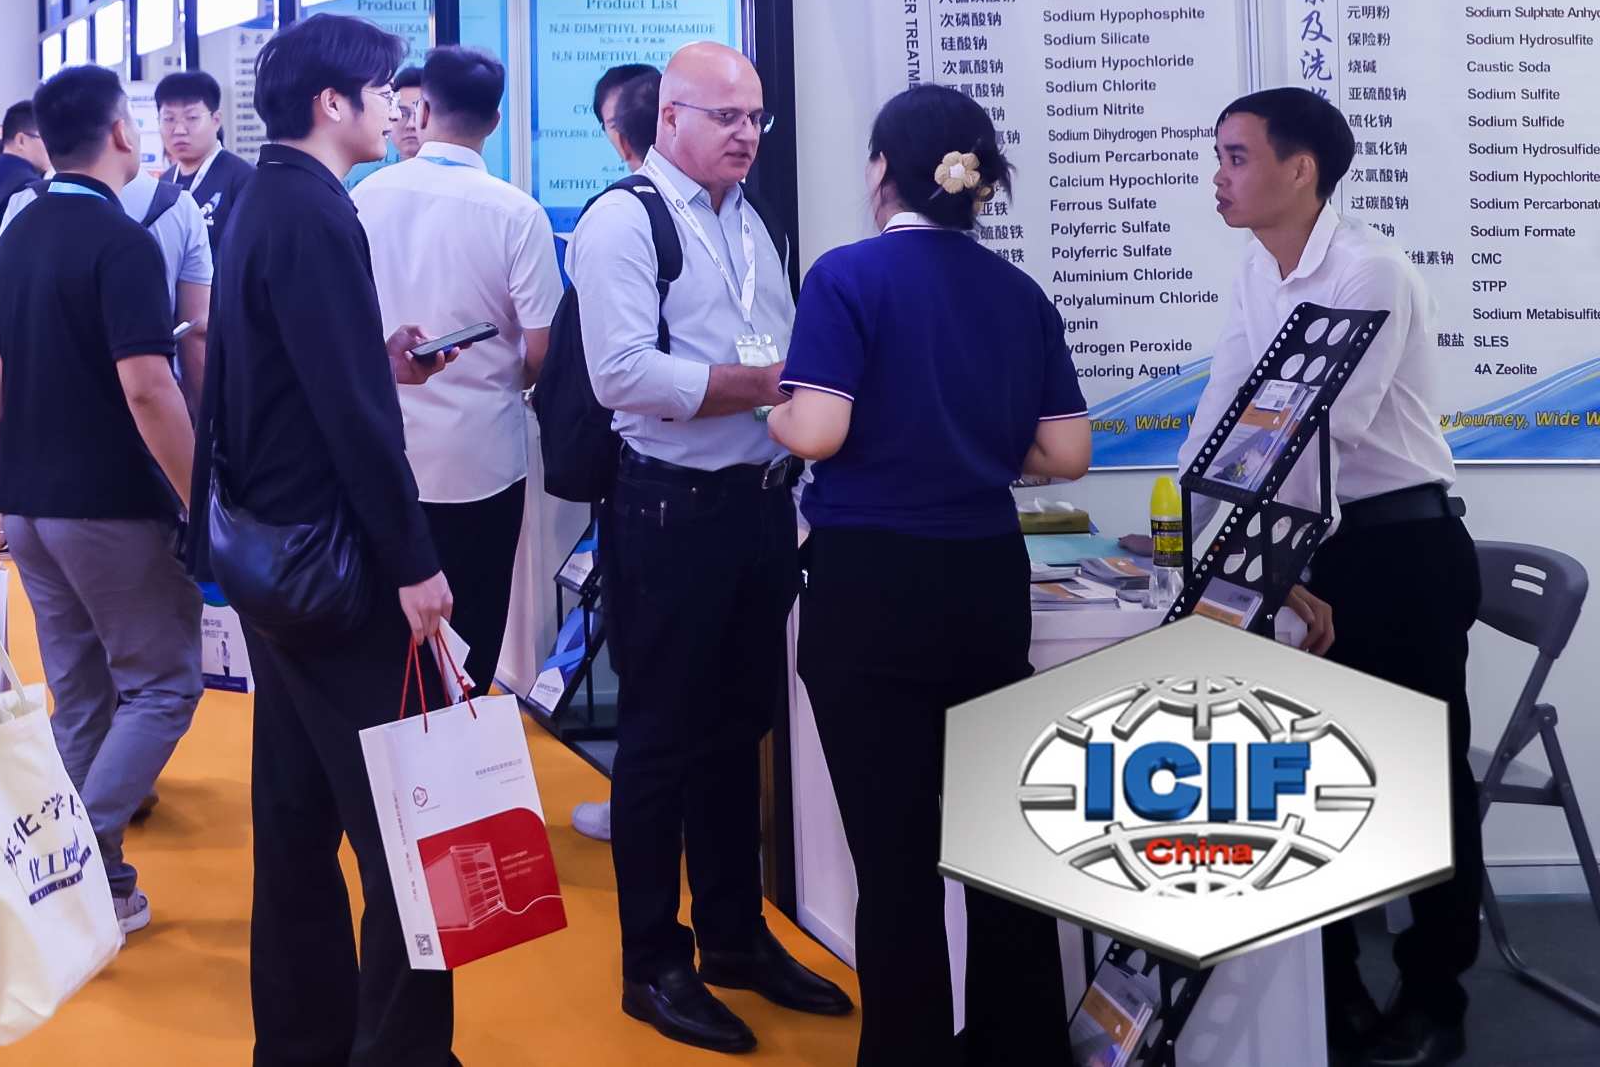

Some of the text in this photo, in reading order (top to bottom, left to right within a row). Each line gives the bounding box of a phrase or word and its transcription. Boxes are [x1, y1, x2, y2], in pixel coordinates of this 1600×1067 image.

[940, 11, 1002, 28] 次磷酸钠
[1043, 6, 1205, 24] Sodium Hypophosphite
[1347, 5, 1390, 20] 元明粉
[1465, 6, 1512, 18] Sodium
[1514, 6, 1565, 21] Sulphate
[940, 35, 988, 52] 硅酸钠
[1043, 32, 1150, 46] Sodium Silicate
[1347, 32, 1391, 47] 保险粉
[1466, 33, 1594, 49] Sodium Hydrosulfite
[906, 18, 921, 90] TREATM
[1044, 53, 1194, 71] Sodium Hypochloride
[1347, 59, 1377, 74] 烧碱
[1466, 60, 1551, 73] Caustic Soda
[1045, 78, 1157, 94] Sodium Chlorite
[1348, 86, 1407, 101] 亚硫酸钠
[1467, 87, 1561, 100] Sodium Sulfite
[1046, 102, 1145, 117] Sodium Nitrite
[1348, 113, 1393, 128] 硫化钠
[1468, 115, 1565, 128] Sodium Sulfide
[1048, 126, 1216, 143] Sodium Dihydrogen Phosphat
[1048, 149, 1199, 165] Sodium Percarbonate
[1468, 142, 1600, 158] Sodium Hydrosulfide
[1049, 172, 1199, 190] Calcium Hypochlorite
[1469, 170, 1600, 186] Sodium Hypochlorite
[1050, 197, 1157, 212] Ferrous Sulfate
[1351, 195, 1409, 210] 过碳酸钠
[1470, 197, 1520, 210] Sodium
[1050, 220, 1171, 238] Polyferric Sulfate
[1470, 225, 1576, 238] Sodium Formate
[1051, 244, 1172, 262] Polyferric Sulfate
[1471, 252, 1502, 265] CMC
[1052, 267, 1193, 283] Aluminium Chloride
[1472, 280, 1508, 293] STPP
[1054, 291, 1219, 309] Polyaluminum Chloride
[1472, 307, 1522, 320] Sodium
[1068, 339, 1193, 356] ydrogen Peroxide
[1473, 335, 1509, 348] SLES
[1076, 363, 1181, 380] coloring Agent
[1474, 363, 1538, 375] 4A Zeolite
[1136, 415, 1182, 430] Wide
[1453, 411, 1530, 430] Journey,
[1536, 411, 1581, 427] Wide
